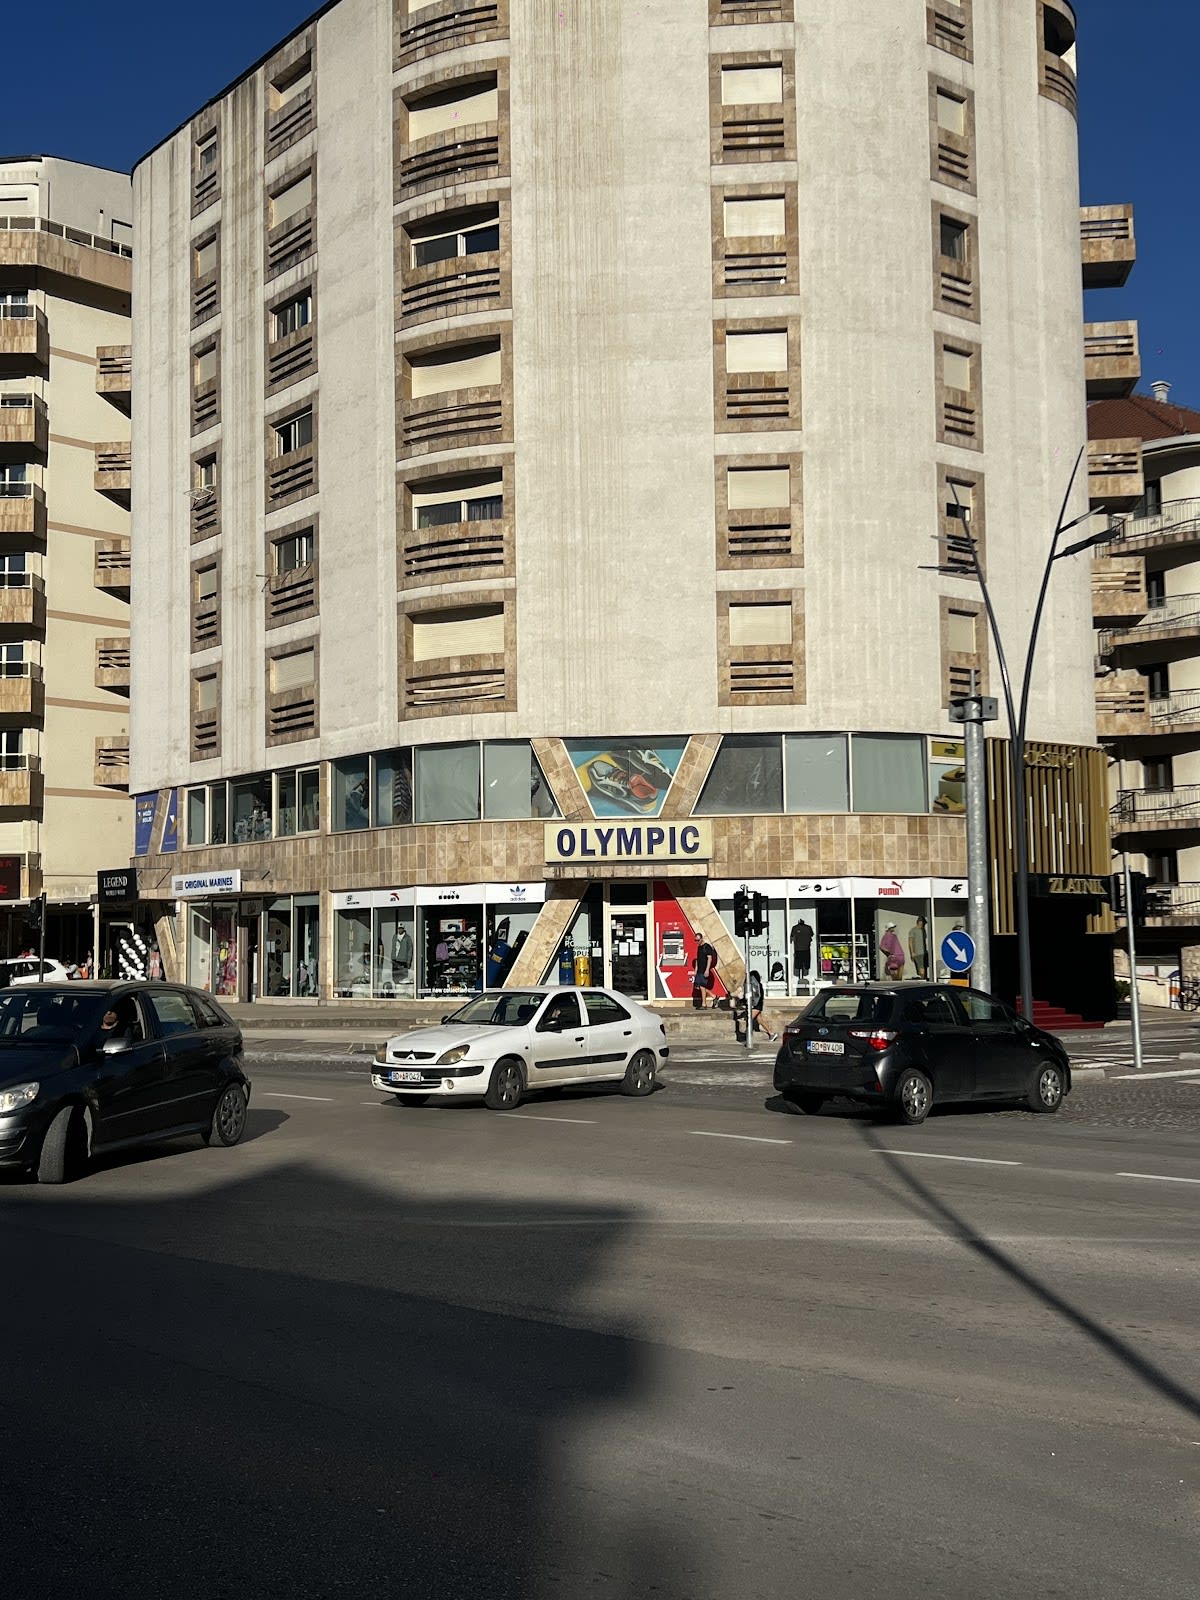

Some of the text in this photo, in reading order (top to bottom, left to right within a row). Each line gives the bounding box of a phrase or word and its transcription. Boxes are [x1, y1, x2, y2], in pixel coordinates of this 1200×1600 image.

[556, 825, 700, 857] OLYMPIC
[103, 876, 128, 888] LEGEND
[184, 877, 233, 889] ORIGINAL MARINES
[1048, 878, 1108, 894] ZLATNIK
[951, 884, 963, 893] 4F
